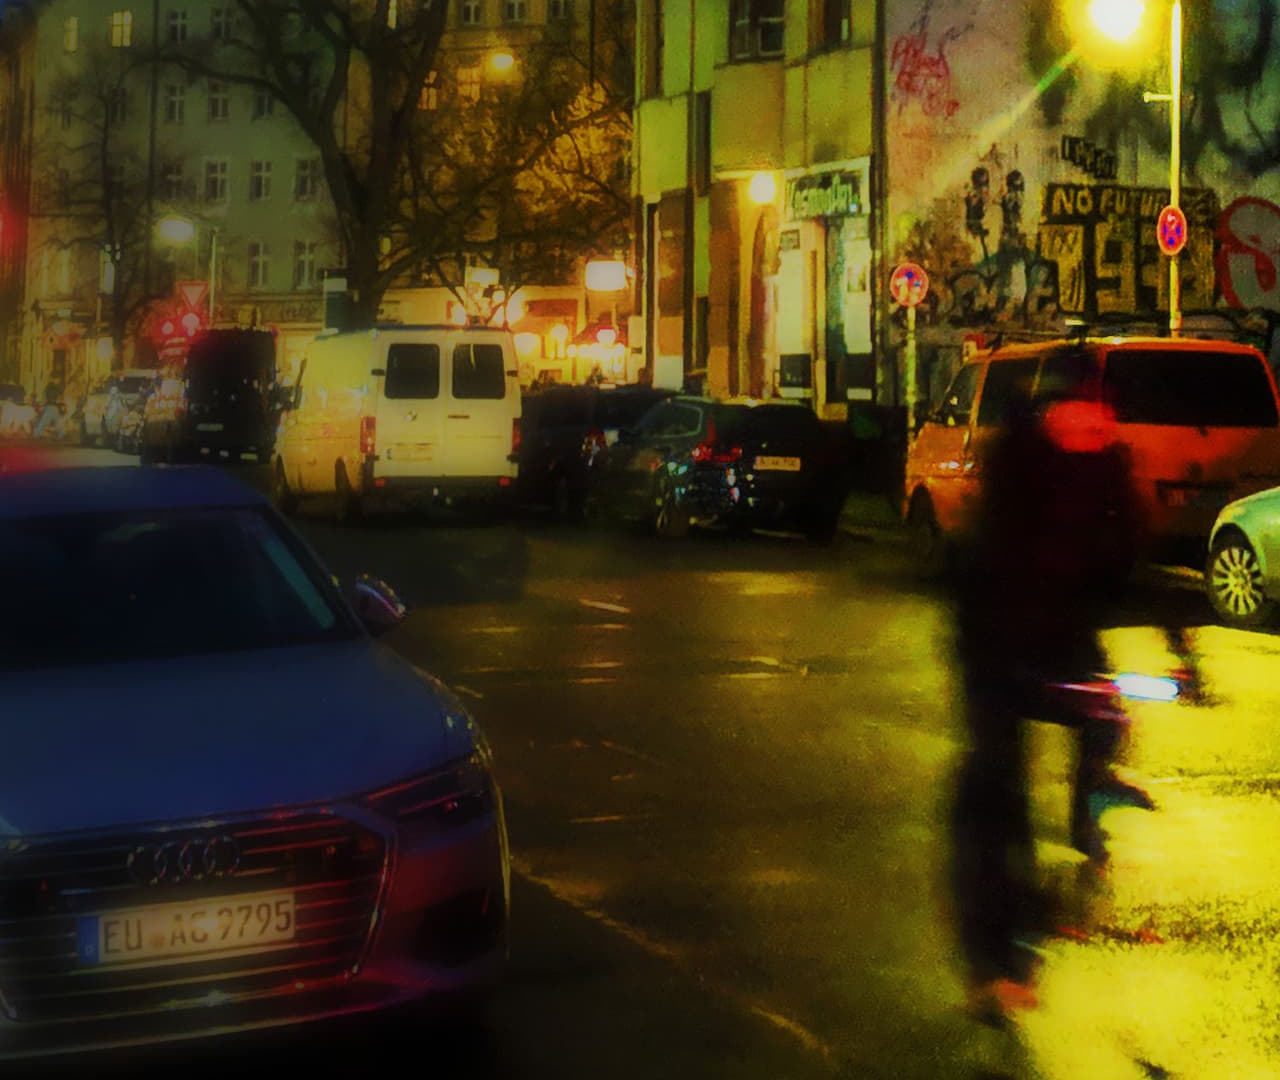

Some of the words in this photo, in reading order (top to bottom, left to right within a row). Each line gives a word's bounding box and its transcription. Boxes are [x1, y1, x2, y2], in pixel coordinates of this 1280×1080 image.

[1052, 188, 1092, 216] NO
[104, 919, 142, 953] EU
[217, 900, 291, 940] 9795
